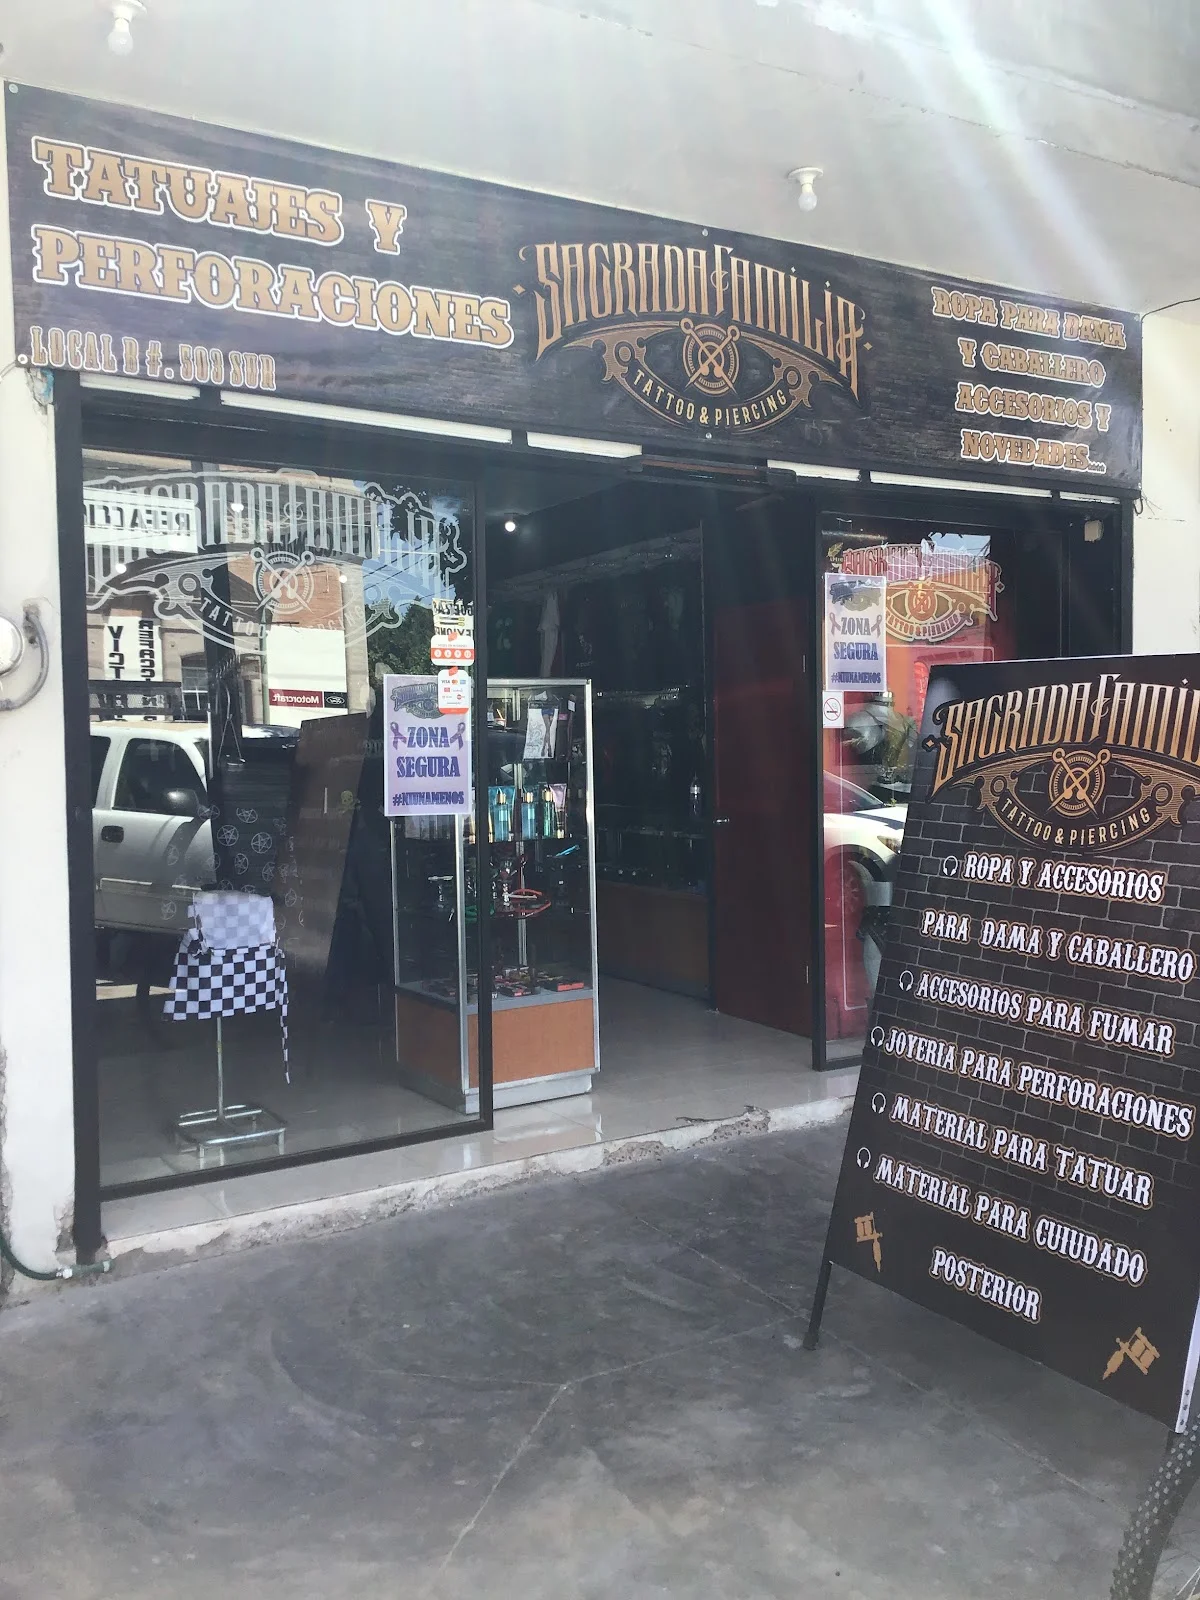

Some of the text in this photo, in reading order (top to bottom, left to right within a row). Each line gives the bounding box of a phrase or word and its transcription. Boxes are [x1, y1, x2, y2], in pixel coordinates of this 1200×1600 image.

[31, 136, 407, 255] TATUAJES Y
[31, 224, 514, 348] PERFORACIONES
[931, 286, 1126, 350] ROPA PARA DAMA
[519, 241, 866, 401] SAGRADA FAMILIA
[30, 326, 118, 373] LOCAL
[179, 344, 224, 385] 503
[229, 351, 276, 391] SUR
[958, 337, 1106, 388] Y CABALLERO
[633, 369, 787, 426] TATTOO & PIERCING
[955, 382, 1111, 431] ACCESORIOS Y
[200, 597, 267, 641] TATTOO
[840, 617, 871, 636] ZONA
[833, 642, 878, 661] SEGURA
[396, 756, 460, 778] SEGURA
[406, 726, 449, 748] ZONA
[933, 683, 1092, 798] SAGRADA
[392, 791, 464, 806] #NIUNAMENOS
[1001, 798, 1150, 846] TATTOO & PIERCING
[963, 852, 1166, 903] ROPA Y ACCESORIOS
[920, 908, 1195, 981] PARA DAMA Y CABALLERO
[916, 972, 1175, 1057] ACCESORIOS PARA FUMAR
[885, 1027, 1195, 1140] JOYERIA PARA PERFORACIONES
[889, 1095, 1154, 1208] MATERIAL PARA TATUAR
[874, 1155, 1147, 1286] MATERIAL PARA CUIUDADO
[929, 1247, 1042, 1323] POSTERIOR
